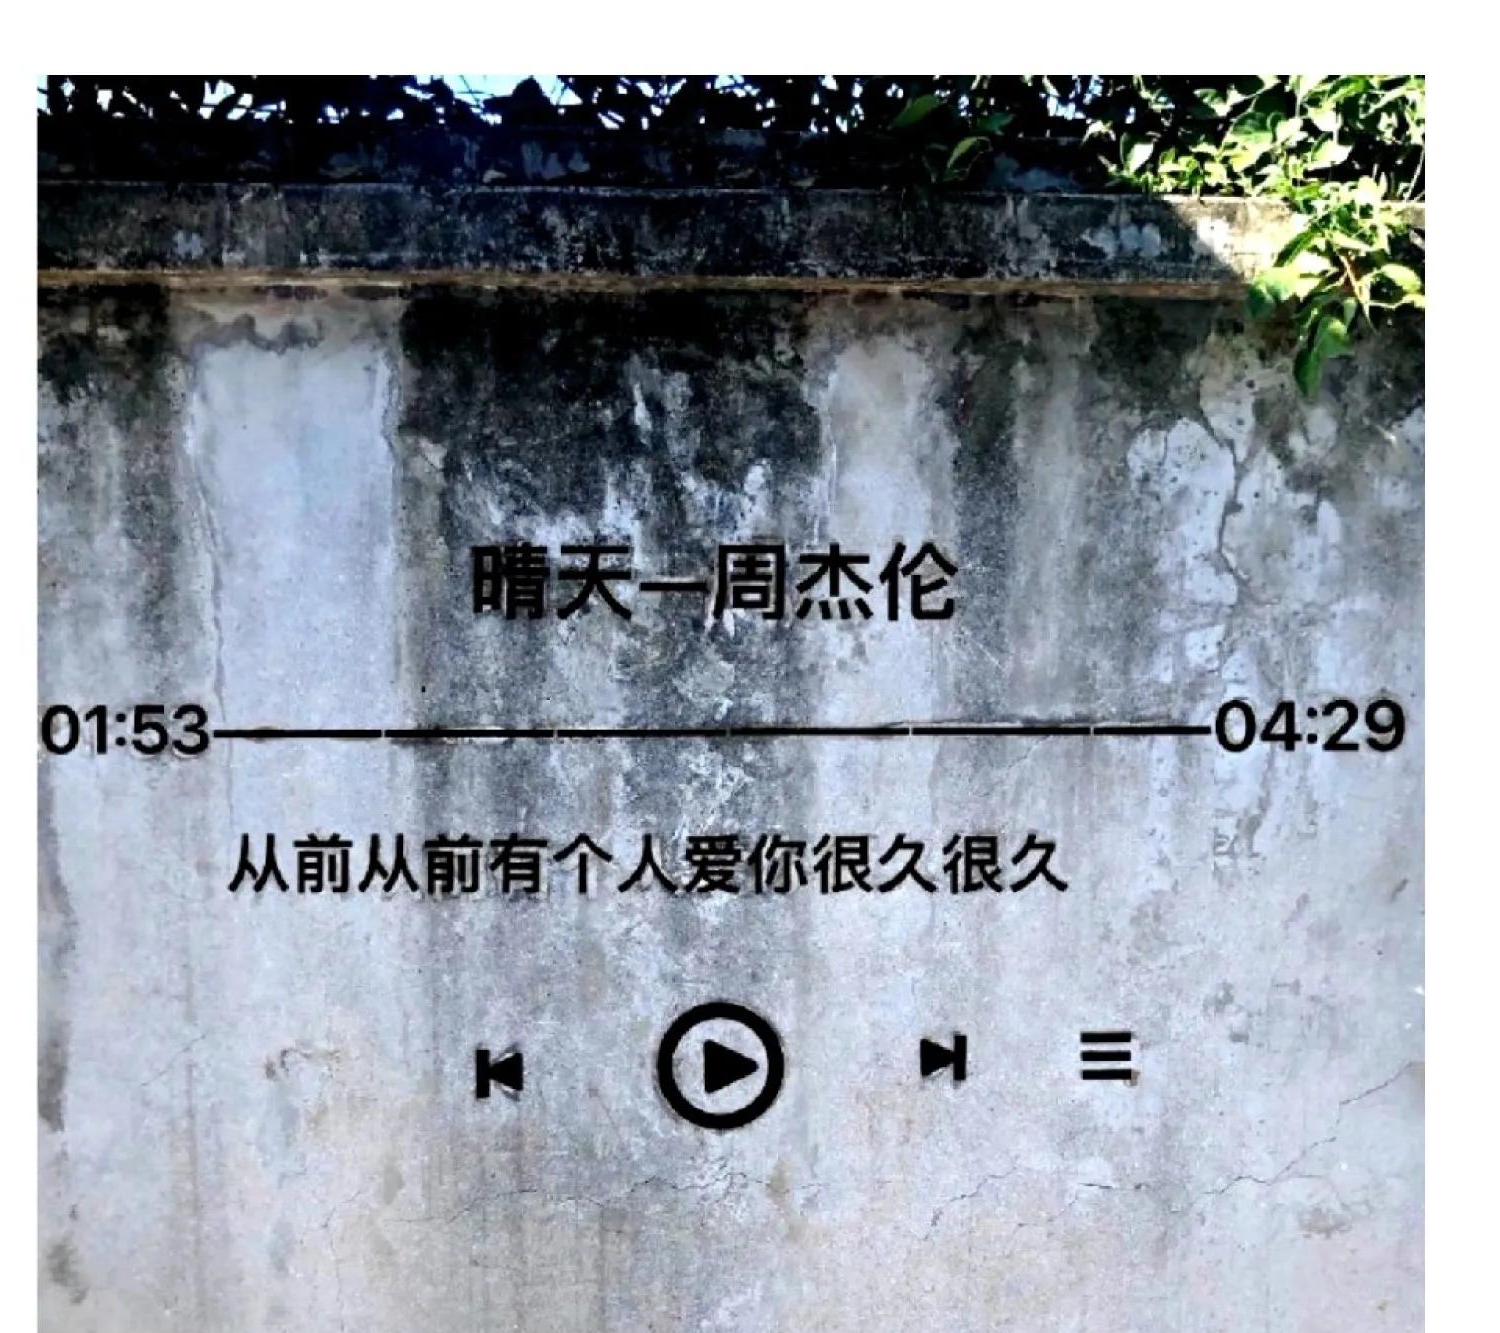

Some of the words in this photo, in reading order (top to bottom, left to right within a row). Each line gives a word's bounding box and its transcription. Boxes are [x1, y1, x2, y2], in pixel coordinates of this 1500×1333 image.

[40, 704, 209, 756] 01:53
[1215, 699, 1406, 753] 04:29
[228, 832, 1069, 896] 从前从前有个人爱你很久很久
